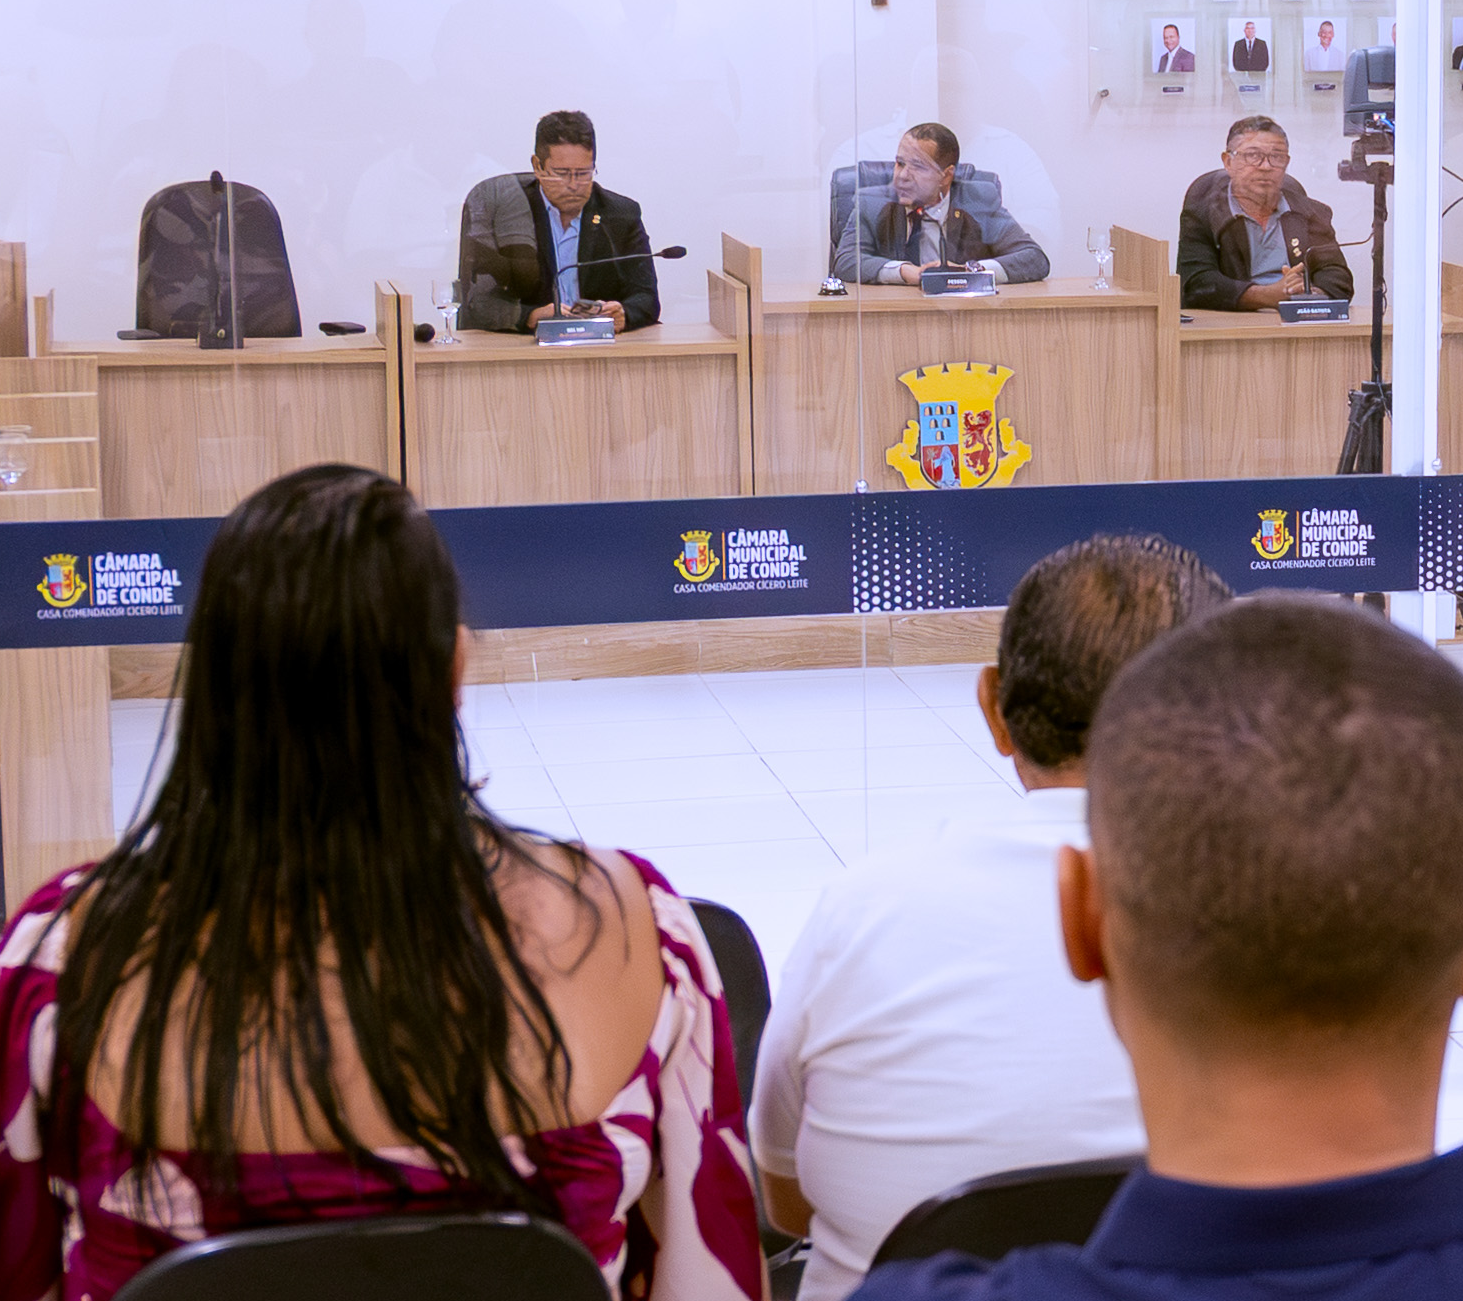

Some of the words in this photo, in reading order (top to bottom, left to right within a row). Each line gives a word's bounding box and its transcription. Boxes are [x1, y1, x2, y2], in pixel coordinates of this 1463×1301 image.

[1302, 508, 1359, 526] CÂMARA
[727, 528, 790, 548] CÂMARA
[1302, 524, 1376, 542] MUNICIPAL
[728, 545, 807, 564] MUNICIPAL
[1302, 542, 1320, 558] DE
[1322, 541, 1368, 557] CONDE
[95, 552, 163, 572] CÂMARA
[729, 564, 748, 580] DE
[750, 562, 799, 579] CONDE
[1250, 560, 1271, 570] CASA
[1272, 558, 1326, 569] COMENDADOR
[1356, 557, 1376, 567] LEITE
[95, 569, 182, 589] MUNICIPAL
[673, 582, 696, 594] CASA
[697, 581, 755, 593] COMENDADOR
[787, 578, 808, 590] LEITE
[96, 588, 118, 606] DE
[120, 587, 174, 605] CONDE
[37, 608, 62, 620] CASA
[62, 606, 125, 619] COMENDADOR
[160, 604, 184, 616] LEITE
